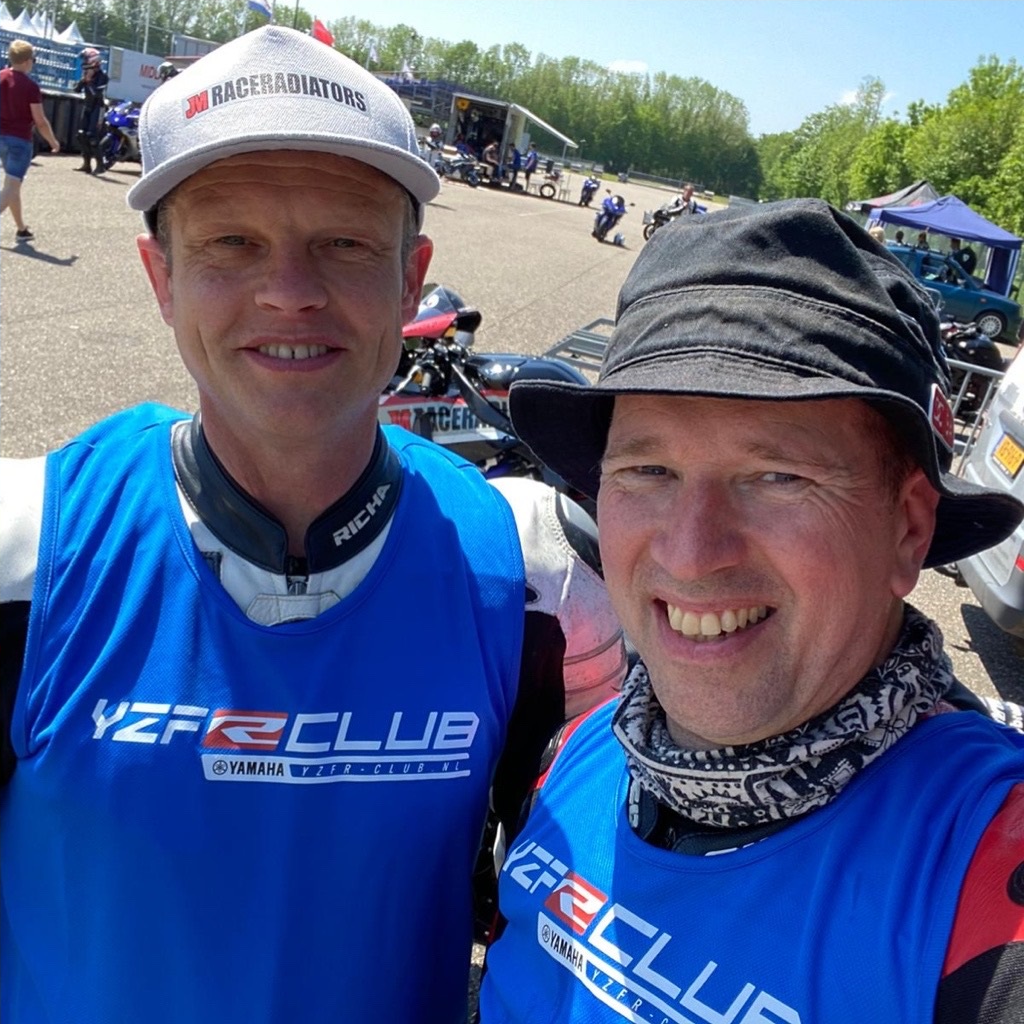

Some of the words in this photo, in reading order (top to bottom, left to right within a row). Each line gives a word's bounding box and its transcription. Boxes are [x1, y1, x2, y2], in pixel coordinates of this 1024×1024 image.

[185, 89, 209, 119] JM
[211, 73, 367, 113] RACERADIATORS
[332, 482, 392, 547] RICHA
[229, 761, 285, 776] YAMAHA
[550, 929, 584, 973] YAMAHA
